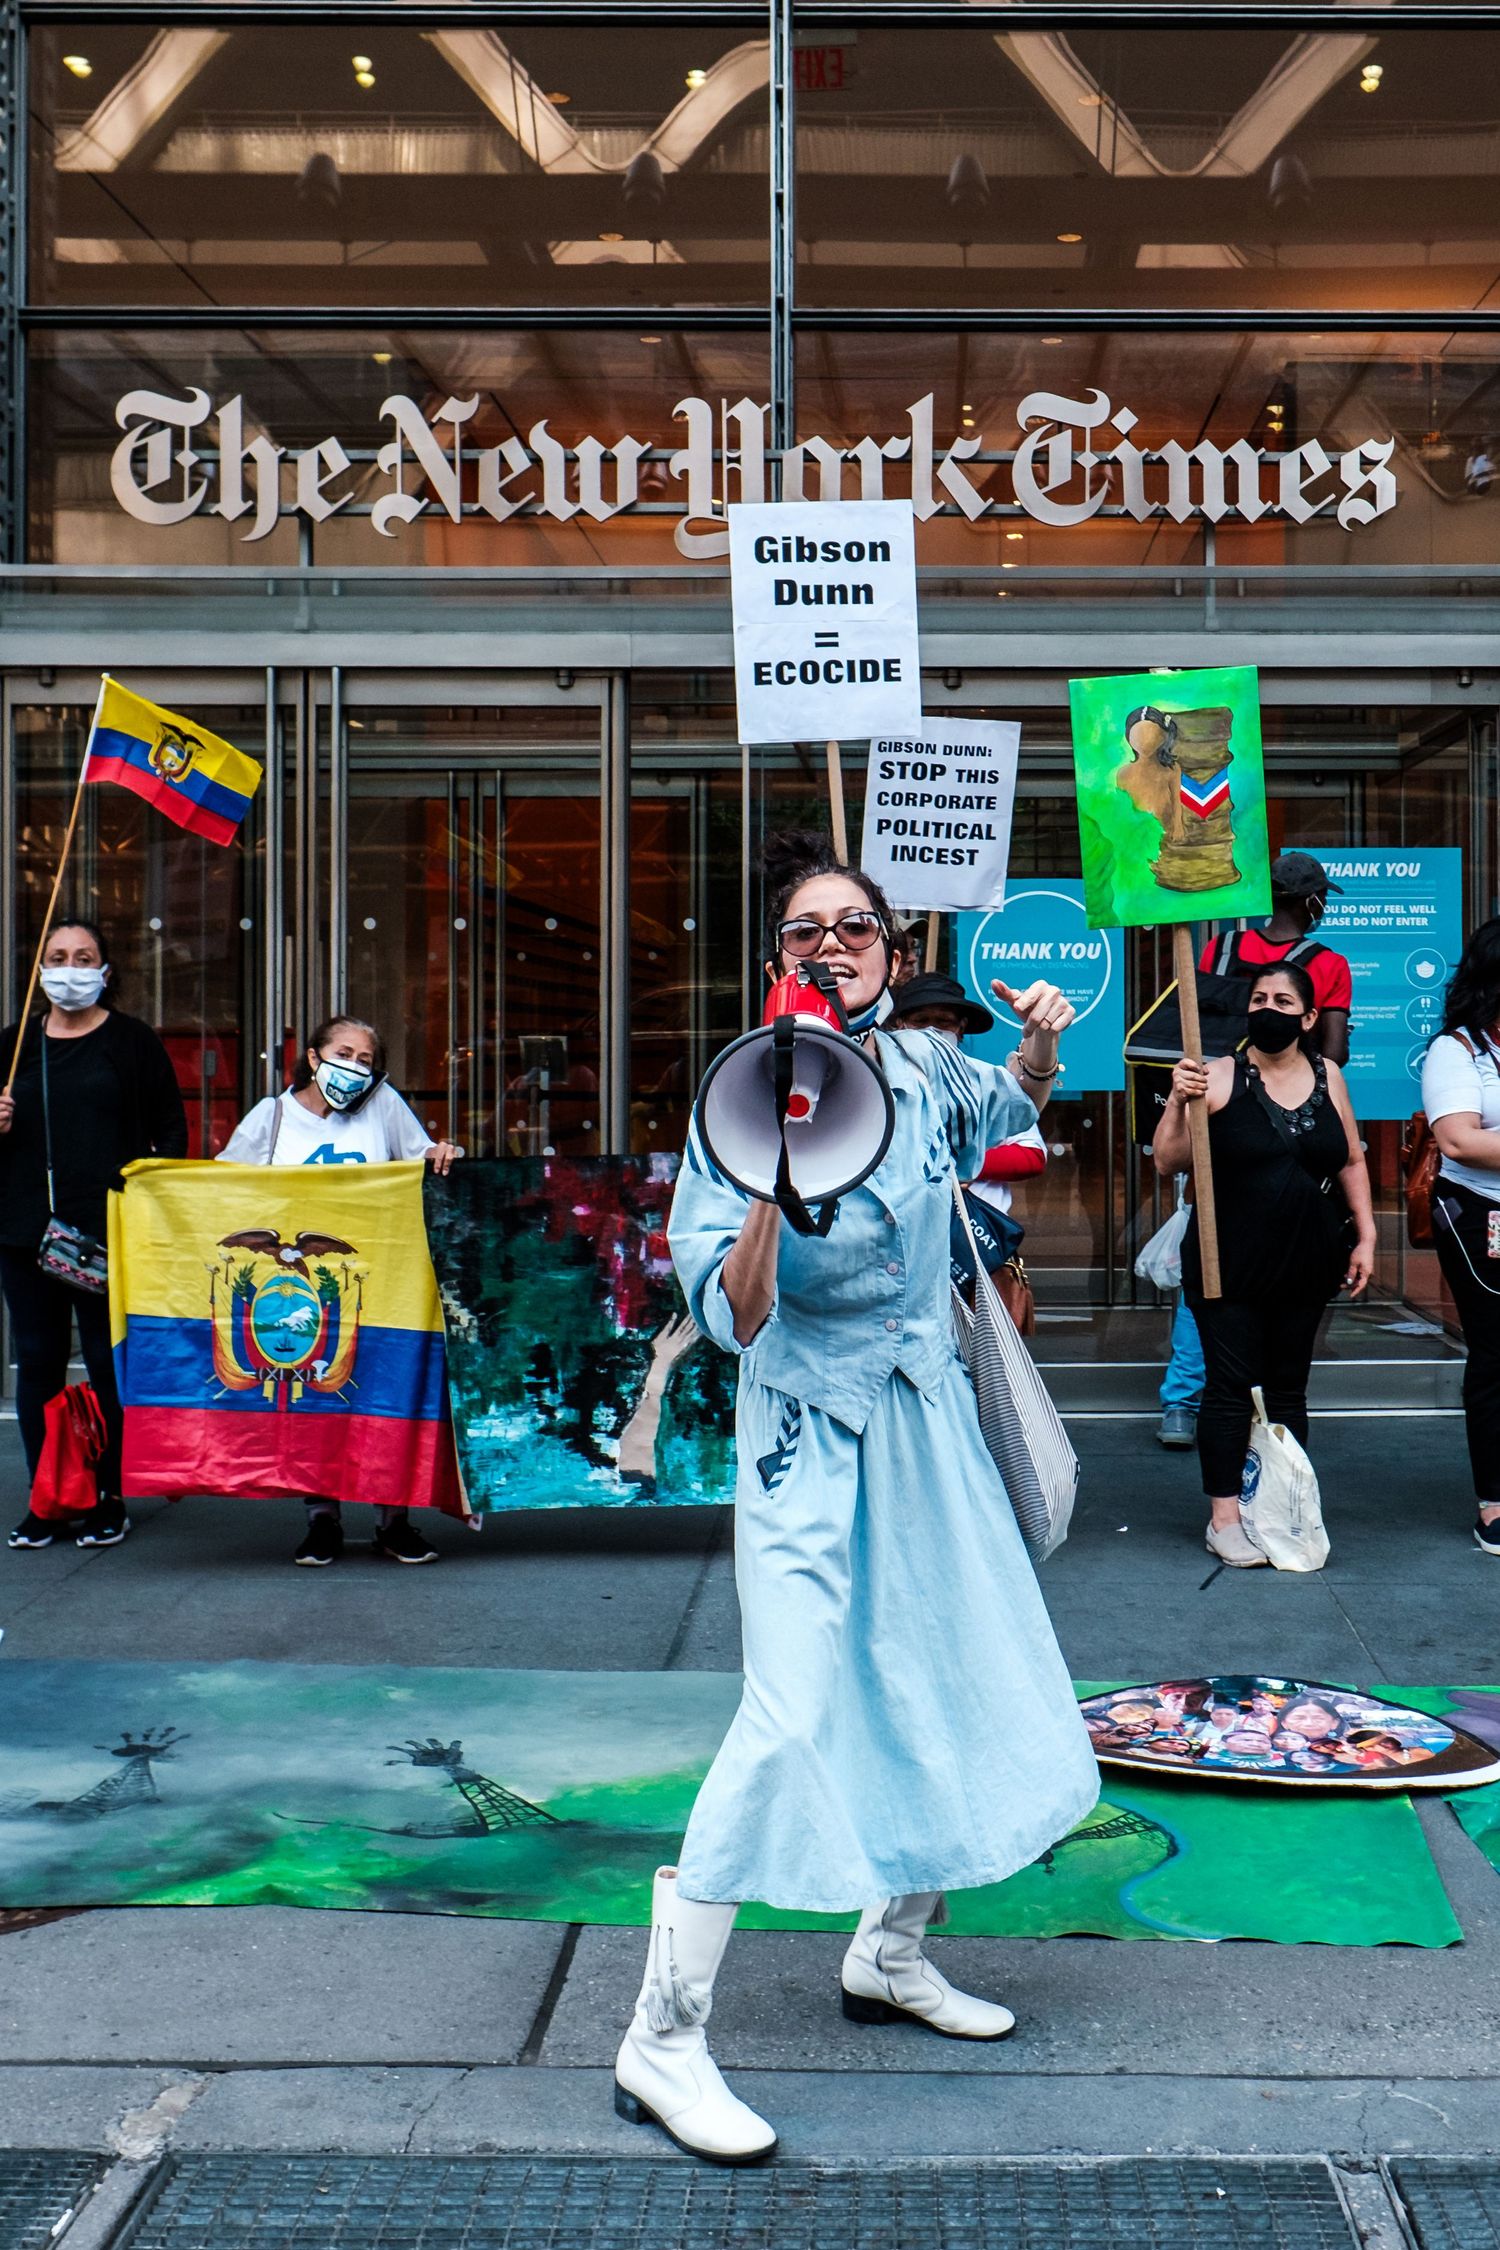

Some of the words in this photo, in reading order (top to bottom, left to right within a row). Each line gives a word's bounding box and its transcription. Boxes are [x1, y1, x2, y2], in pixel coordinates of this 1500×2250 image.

[110, 386, 355, 541] The
[371, 392, 653, 538] New
[669, 392, 994, 560] York
[1011, 387, 1397, 532] Times
[754, 535, 891, 564] Gibson
[774, 578, 874, 606] Dunn
[814, 631, 839, 648] =
[754, 658, 902, 686] ECOCIDE
[877, 741, 937, 755] GIBSON
[943, 744, 993, 758] DUNN:
[879, 760, 947, 782] STOP
[955, 768, 1000, 785] THIS
[877, 791, 998, 811] CORPORATE
[876, 818, 997, 841] POLITICAL
[891, 844, 980, 867] INCEST
[1320, 862, 1381, 878] THANK
[1385, 862, 1421, 878] YOU
[1323, 905, 1339, 914] OU
[1341, 904, 1357, 914] DO
[1359, 904, 1382, 914] NOT
[1384, 904, 1407, 914] FEEL
[1408, 904, 1437, 914] WELL
[1320, 917, 1351, 926] LEASE
[1353, 917, 1369, 926] DO
[1371, 917, 1395, 926] NOT
[1396, 917, 1429, 926] ENTER
[981, 942, 1054, 960] THANK
[1058, 942, 1102, 960] YOU
